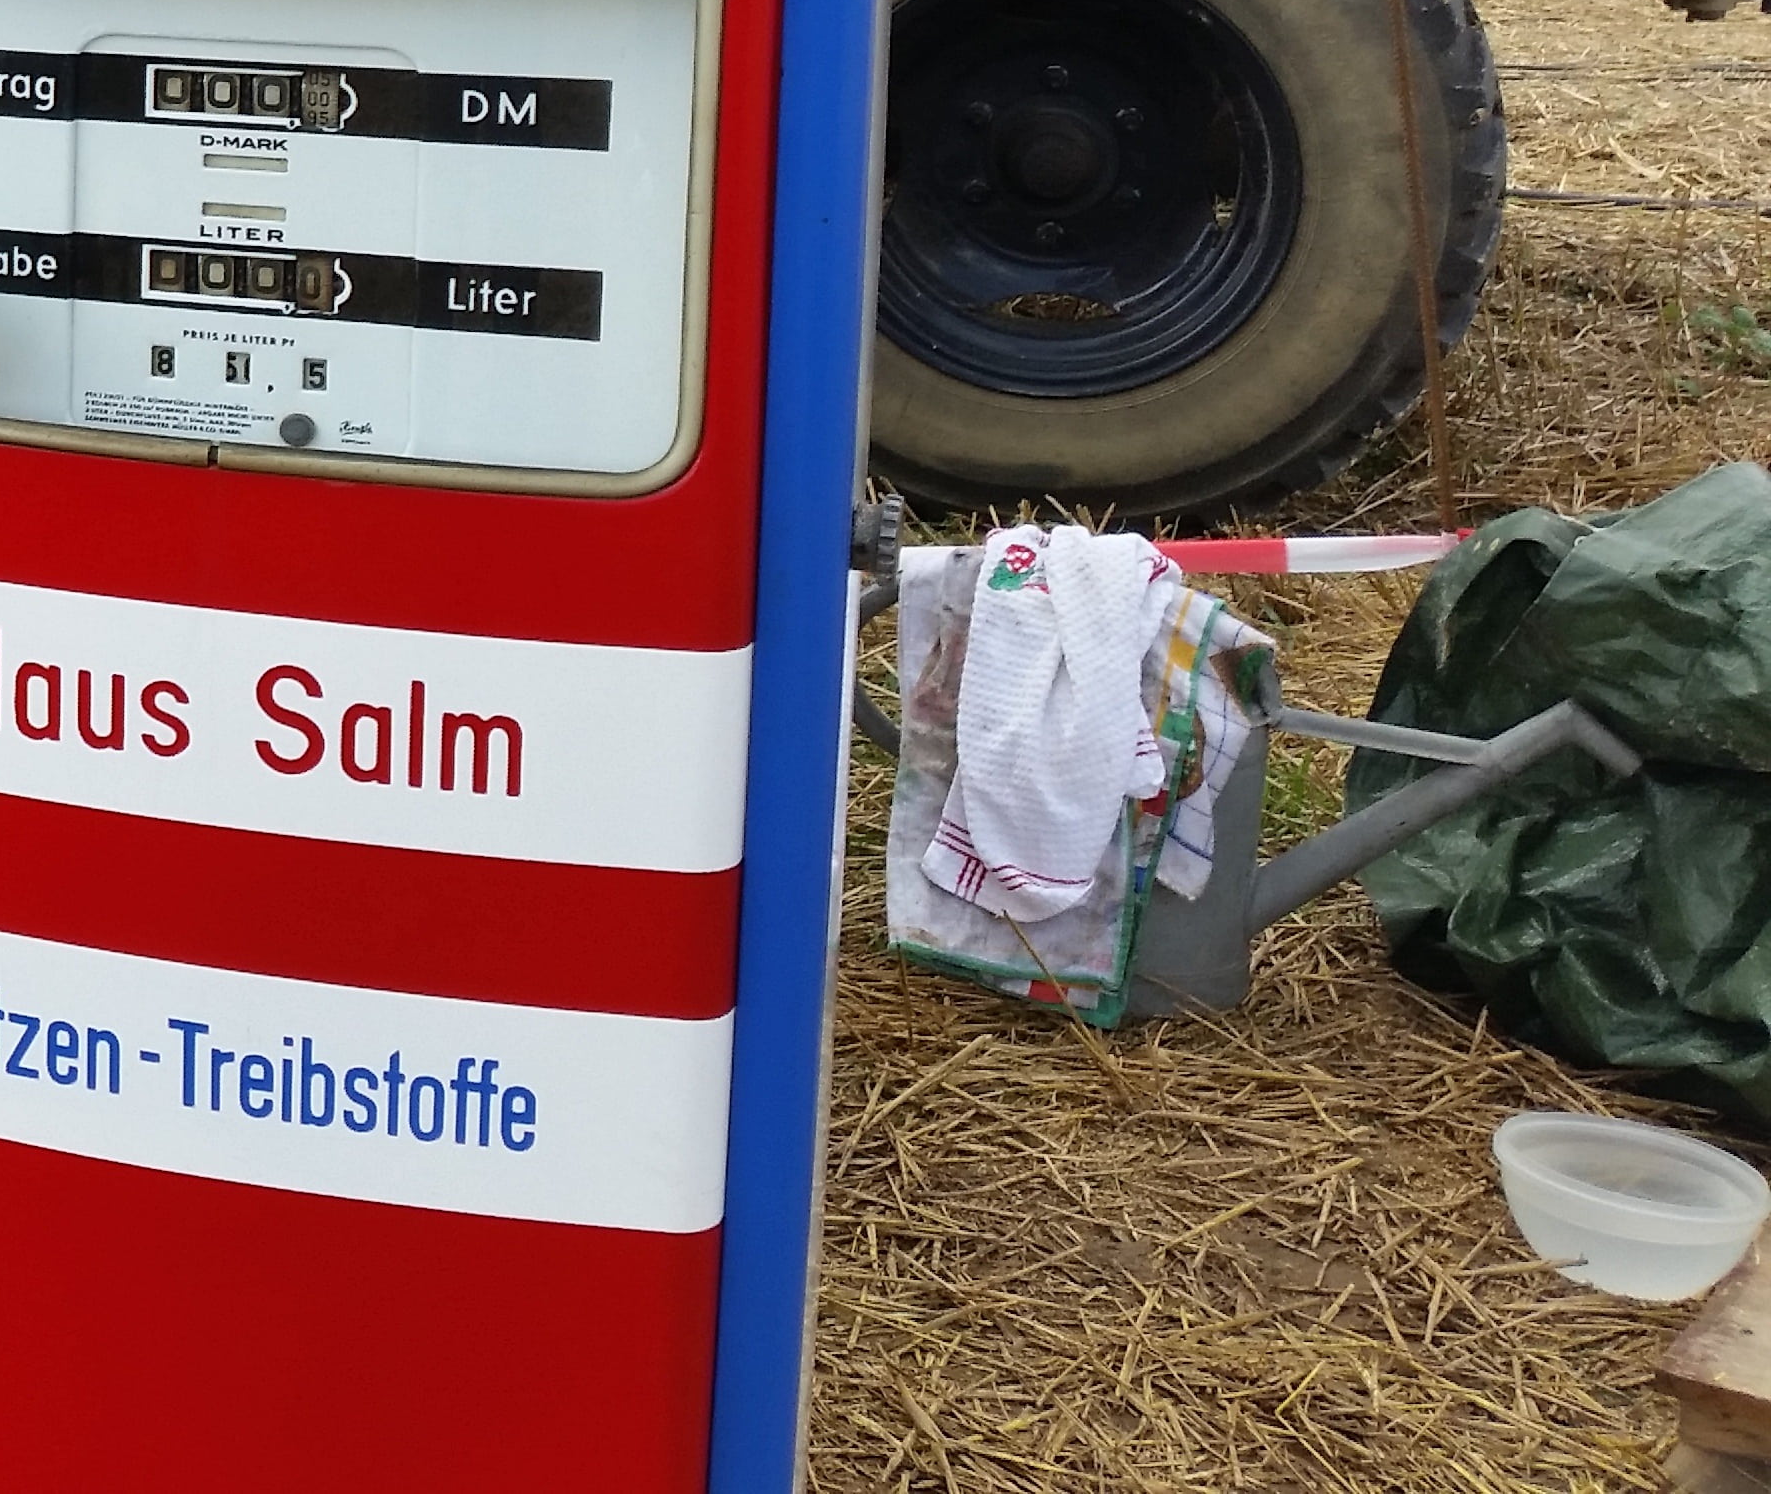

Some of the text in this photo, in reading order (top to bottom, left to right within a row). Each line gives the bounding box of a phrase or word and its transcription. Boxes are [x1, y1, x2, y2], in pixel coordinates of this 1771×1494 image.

[460, 88, 539, 129] DM
[200, 134, 289, 151] D-MARK
[200, 225, 285, 243] LITER
[446, 278, 536, 318] Liter
[183, 329, 218, 342] PREIS
[223, 333, 238, 343] JE
[242, 335, 276, 346] LITER
[254, 663, 525, 800] Salm
